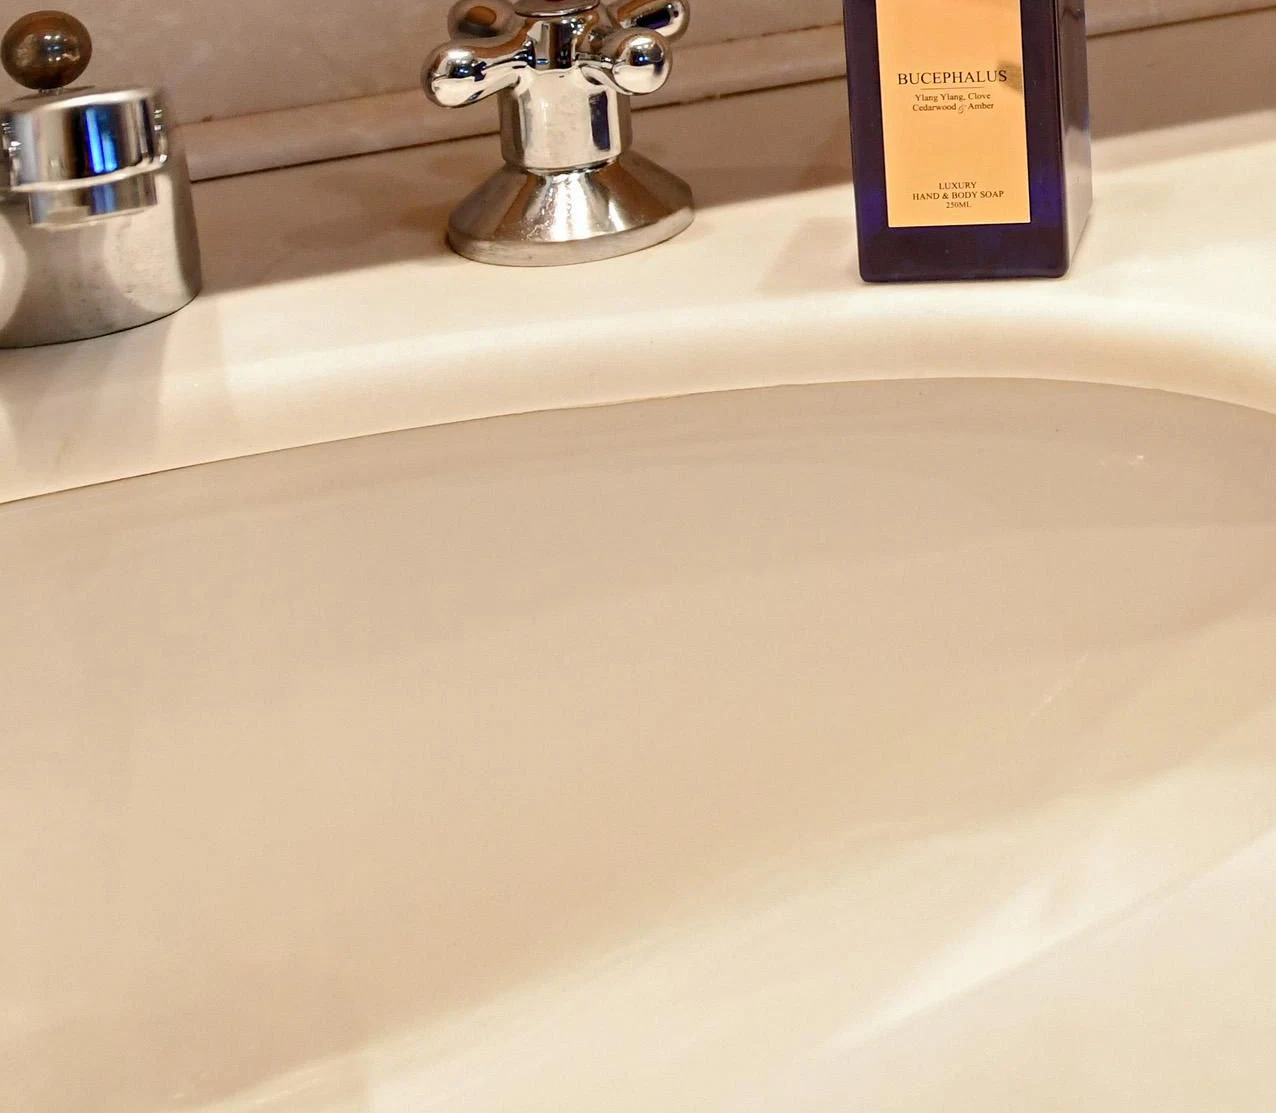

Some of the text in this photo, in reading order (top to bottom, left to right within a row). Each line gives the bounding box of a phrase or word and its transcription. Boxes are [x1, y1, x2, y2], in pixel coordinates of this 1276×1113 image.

[898, 70, 1008, 85] BUCEPHALUS
[915, 94, 939, 103] Ylang
[968, 92, 991, 100] Clove
[912, 103, 957, 112] Cedarwood
[968, 102, 994, 110] Amber
[938, 182, 977, 190] LUXURY
[912, 192, 940, 200] HAND
[951, 191, 978, 199] BODY
[980, 190, 1005, 198] SOAP
